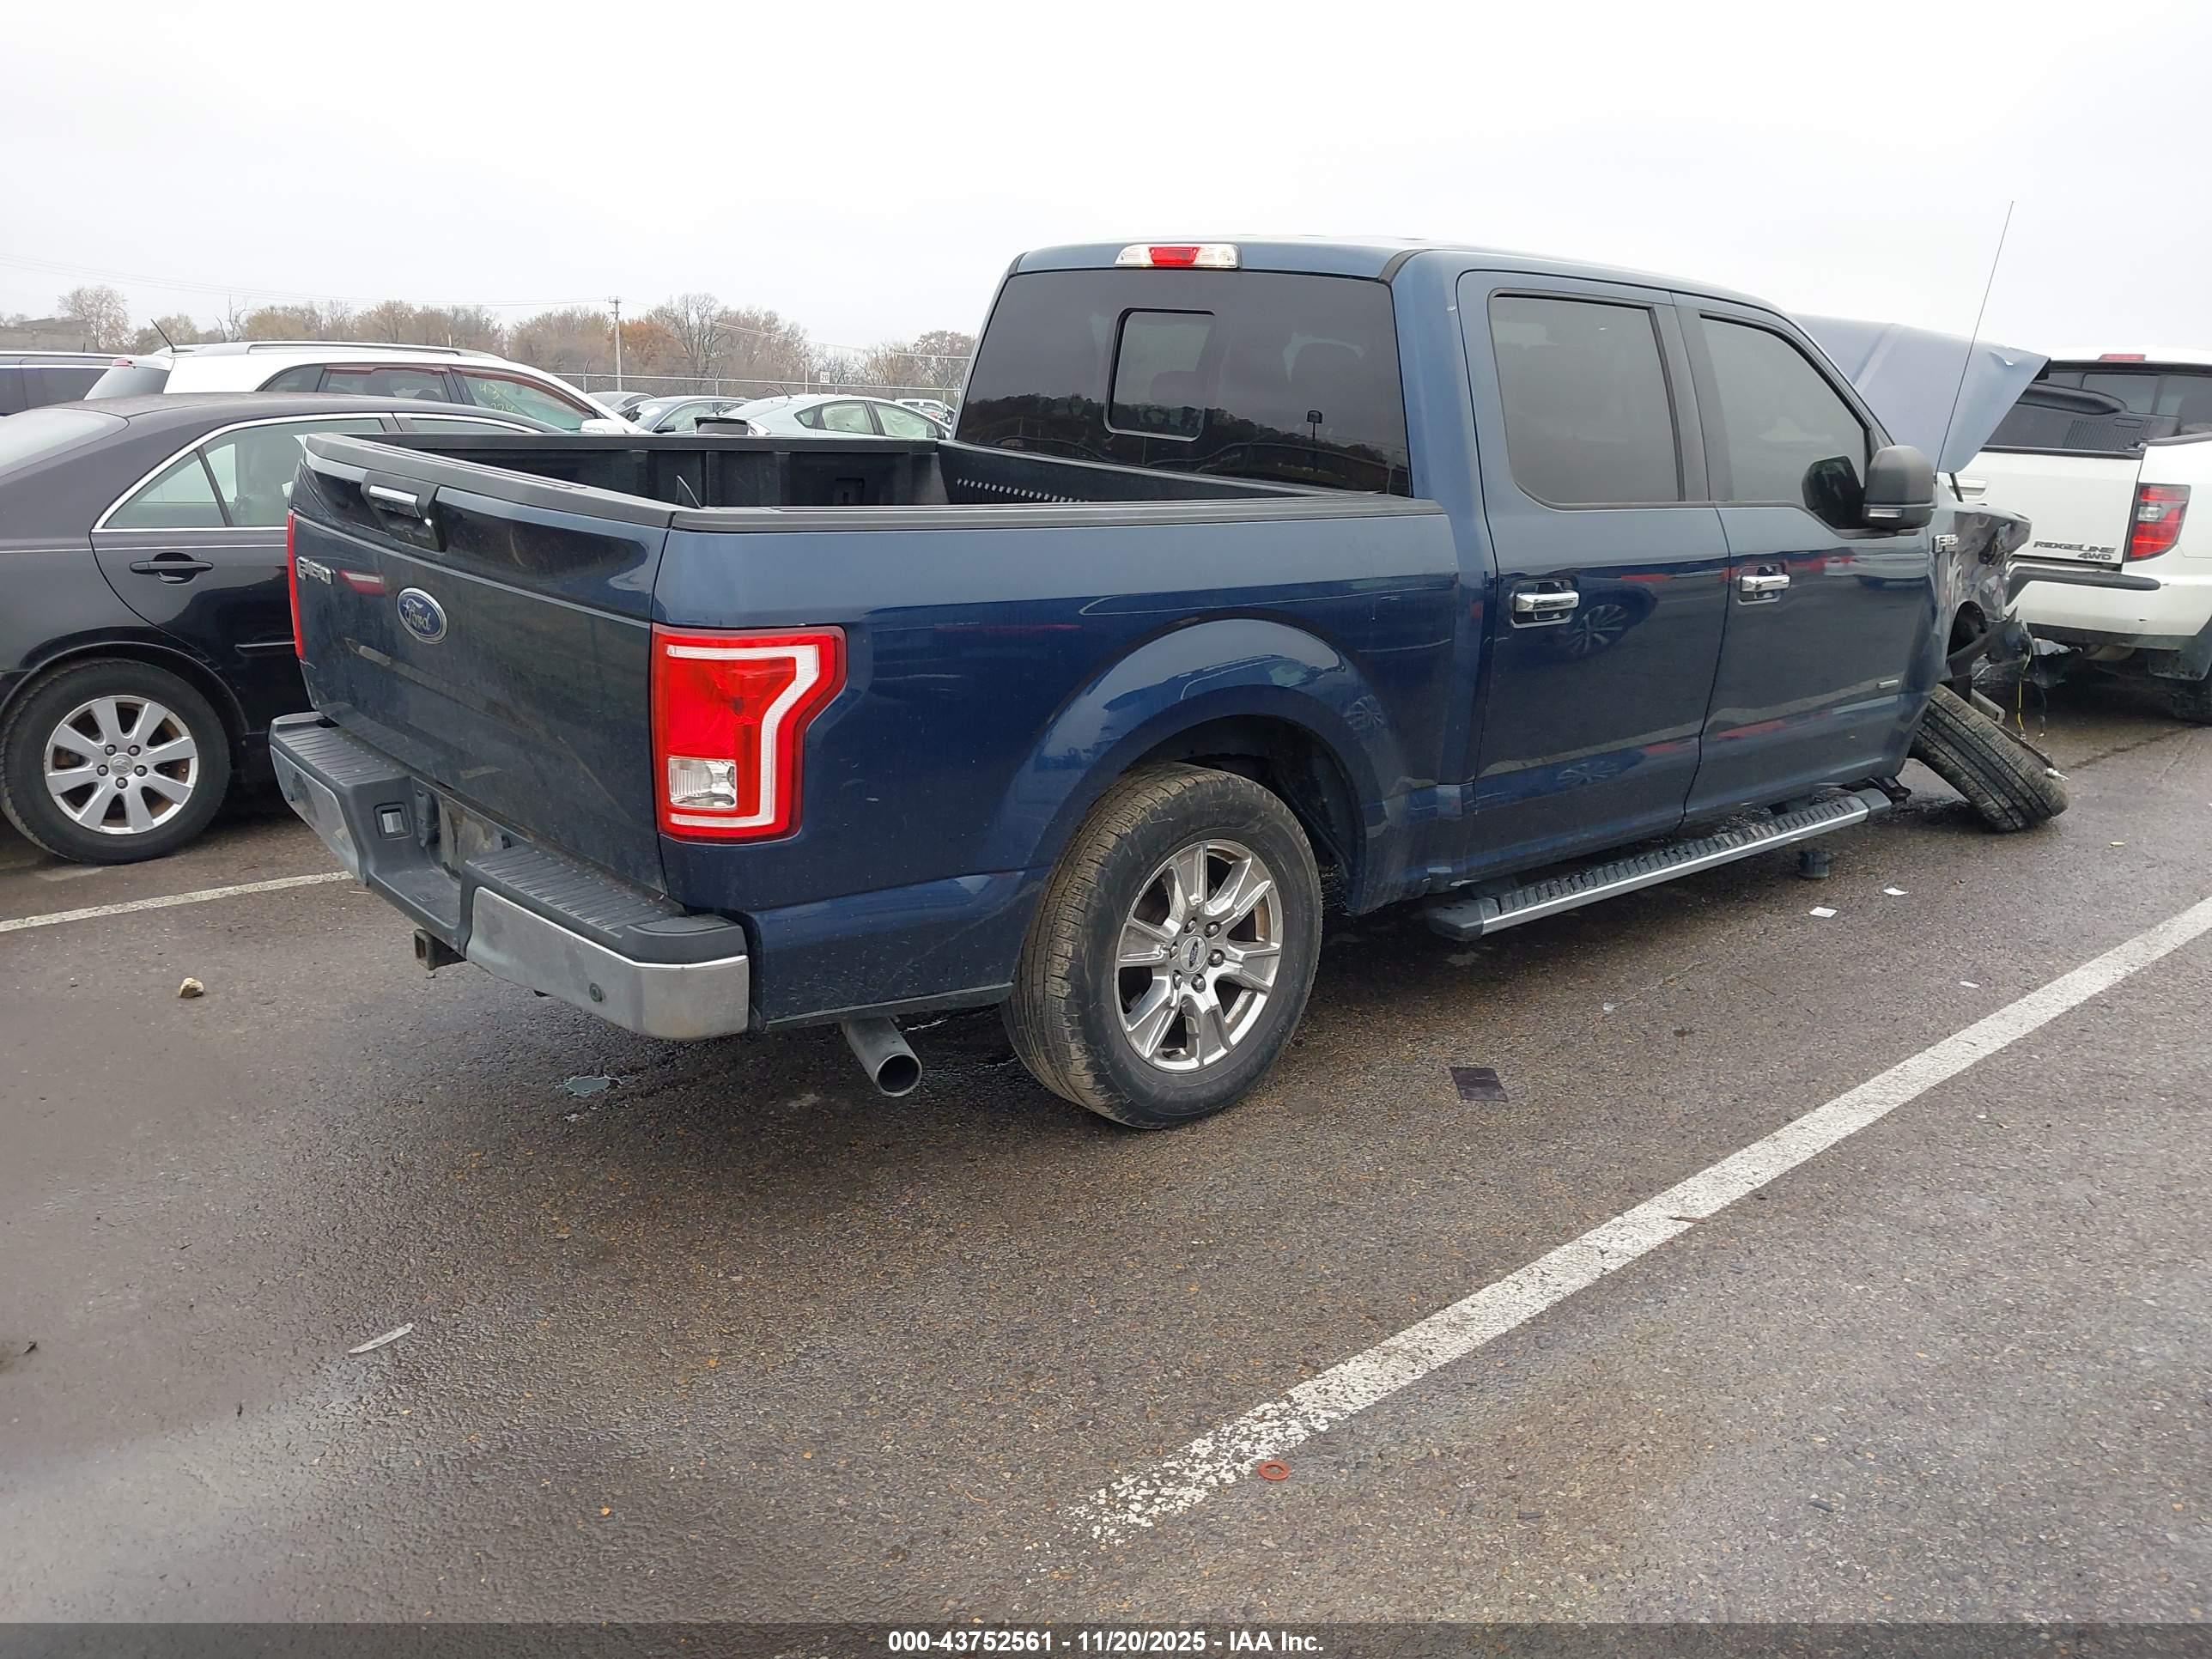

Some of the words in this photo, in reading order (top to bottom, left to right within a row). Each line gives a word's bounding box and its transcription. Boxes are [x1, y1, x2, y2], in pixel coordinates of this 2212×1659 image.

[2033, 540, 2117, 554] RIDGELINE
[2077, 551, 2112, 561] 4WD
[403, 597, 432, 631] Ford
